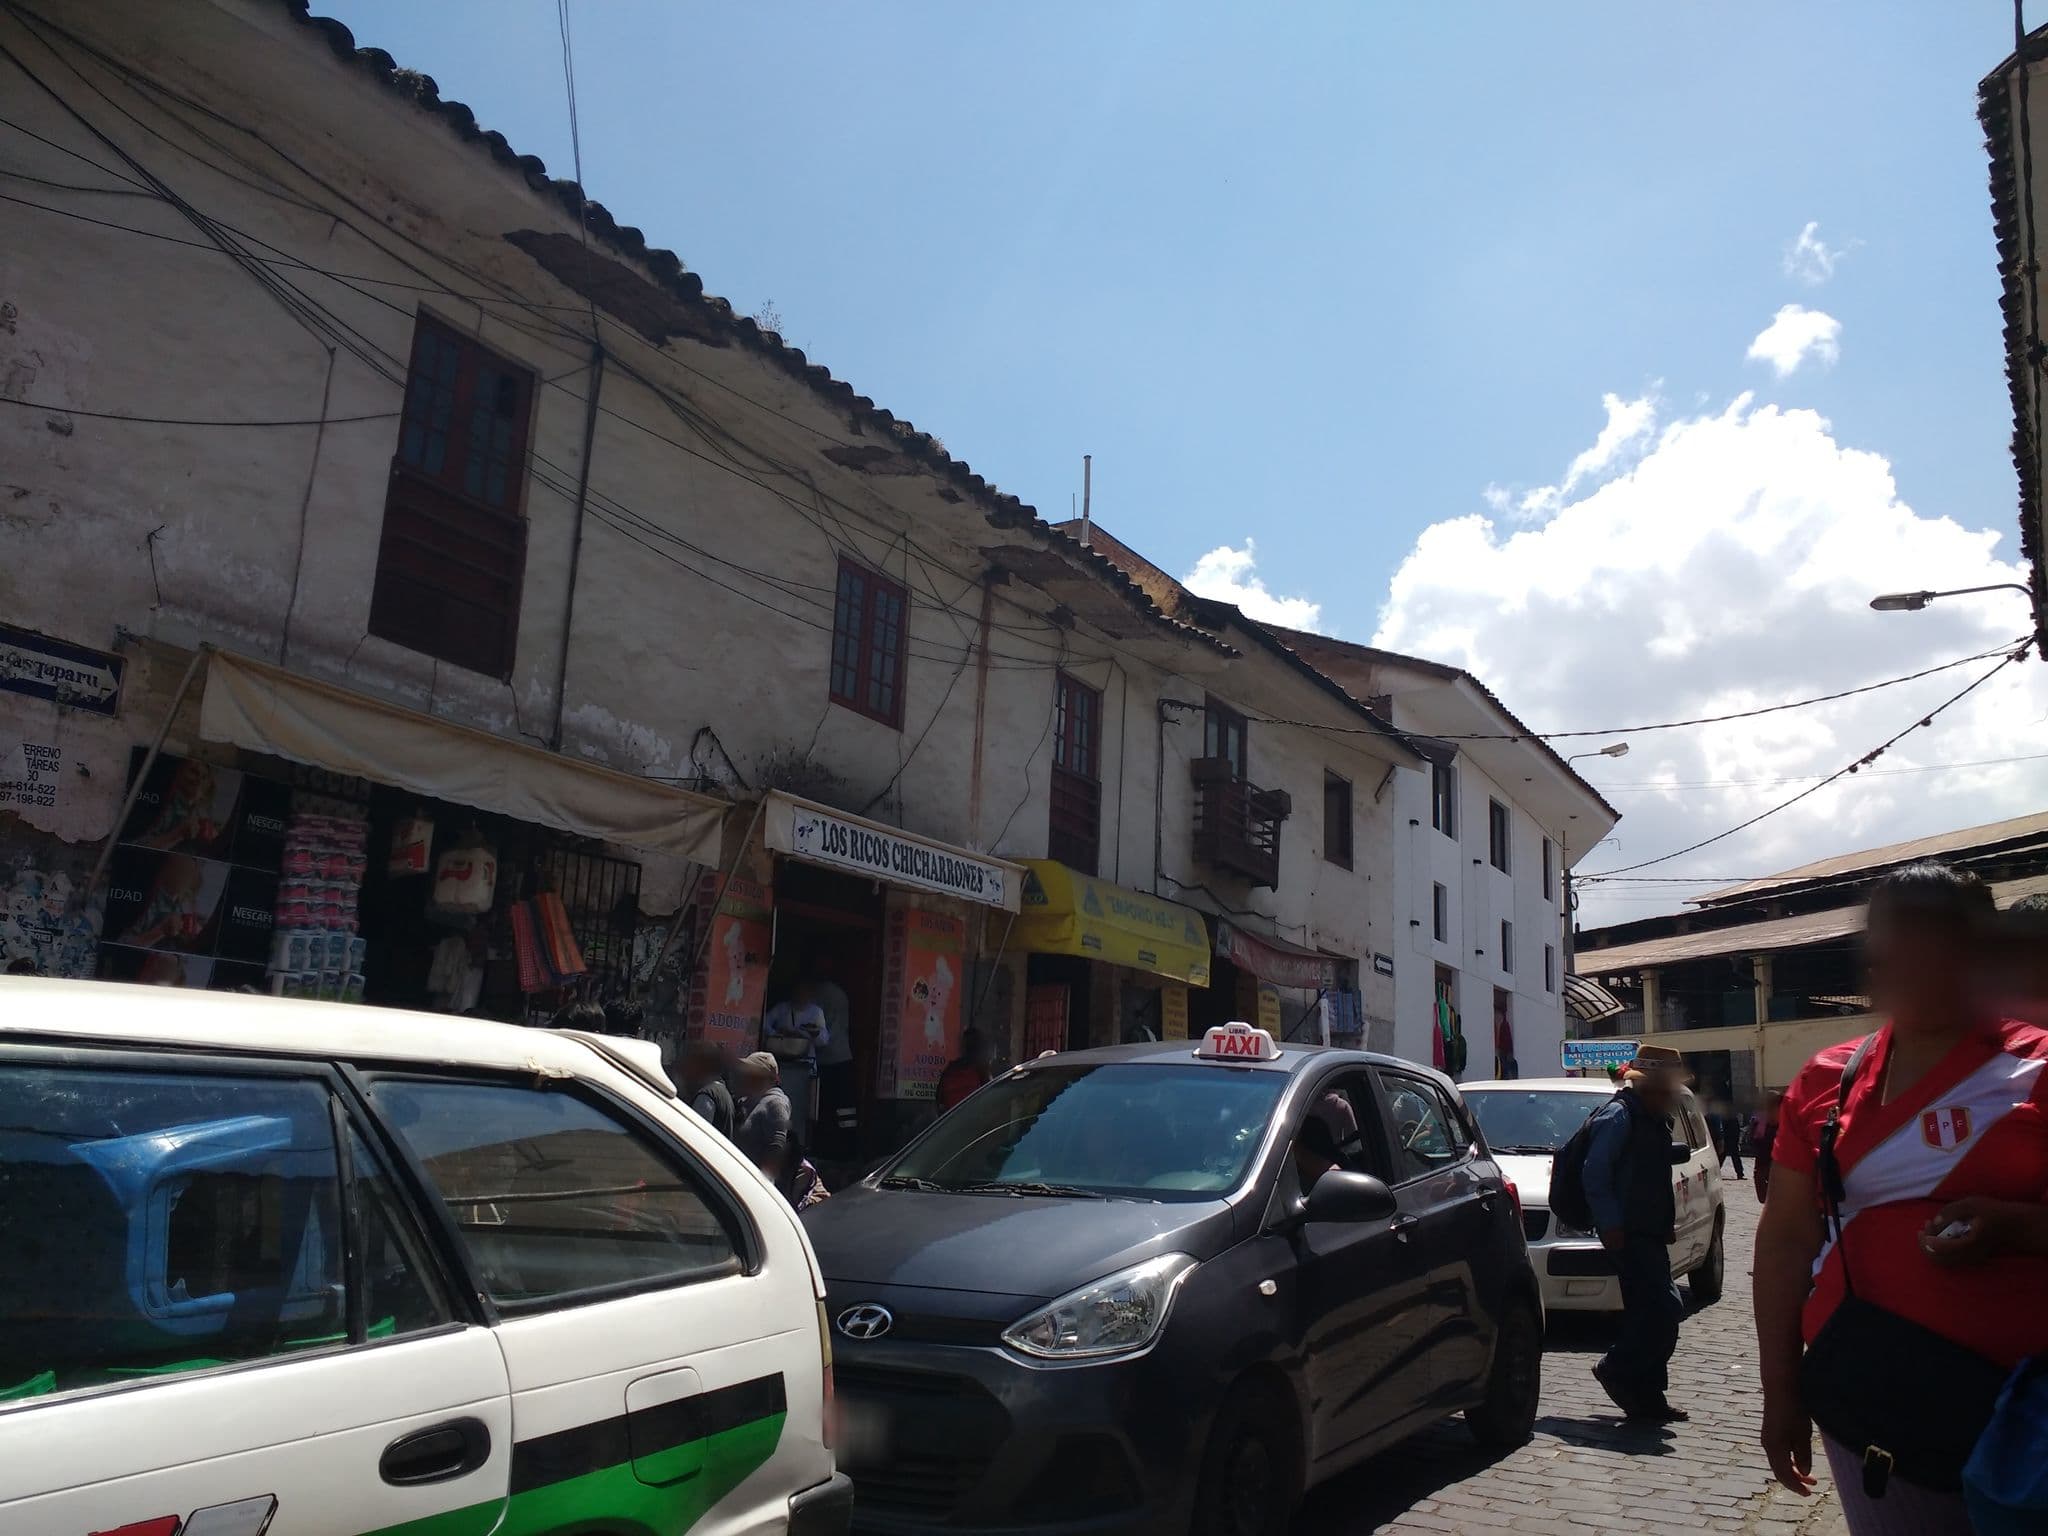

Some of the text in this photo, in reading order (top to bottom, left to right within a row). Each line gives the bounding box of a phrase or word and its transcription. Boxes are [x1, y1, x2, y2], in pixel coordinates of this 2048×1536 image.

[23, 743, 61, 759] ERRENO
[26, 757, 60, 773] TAREAS
[850, 829, 890, 869] RICOS
[1229, 1027, 1247, 1035] LIBRE
[1213, 1034, 1261, 1056] TAXI
[1567, 1043, 1634, 1054] TURISMO
[1568, 1051, 1633, 1060] MILLENIUM
